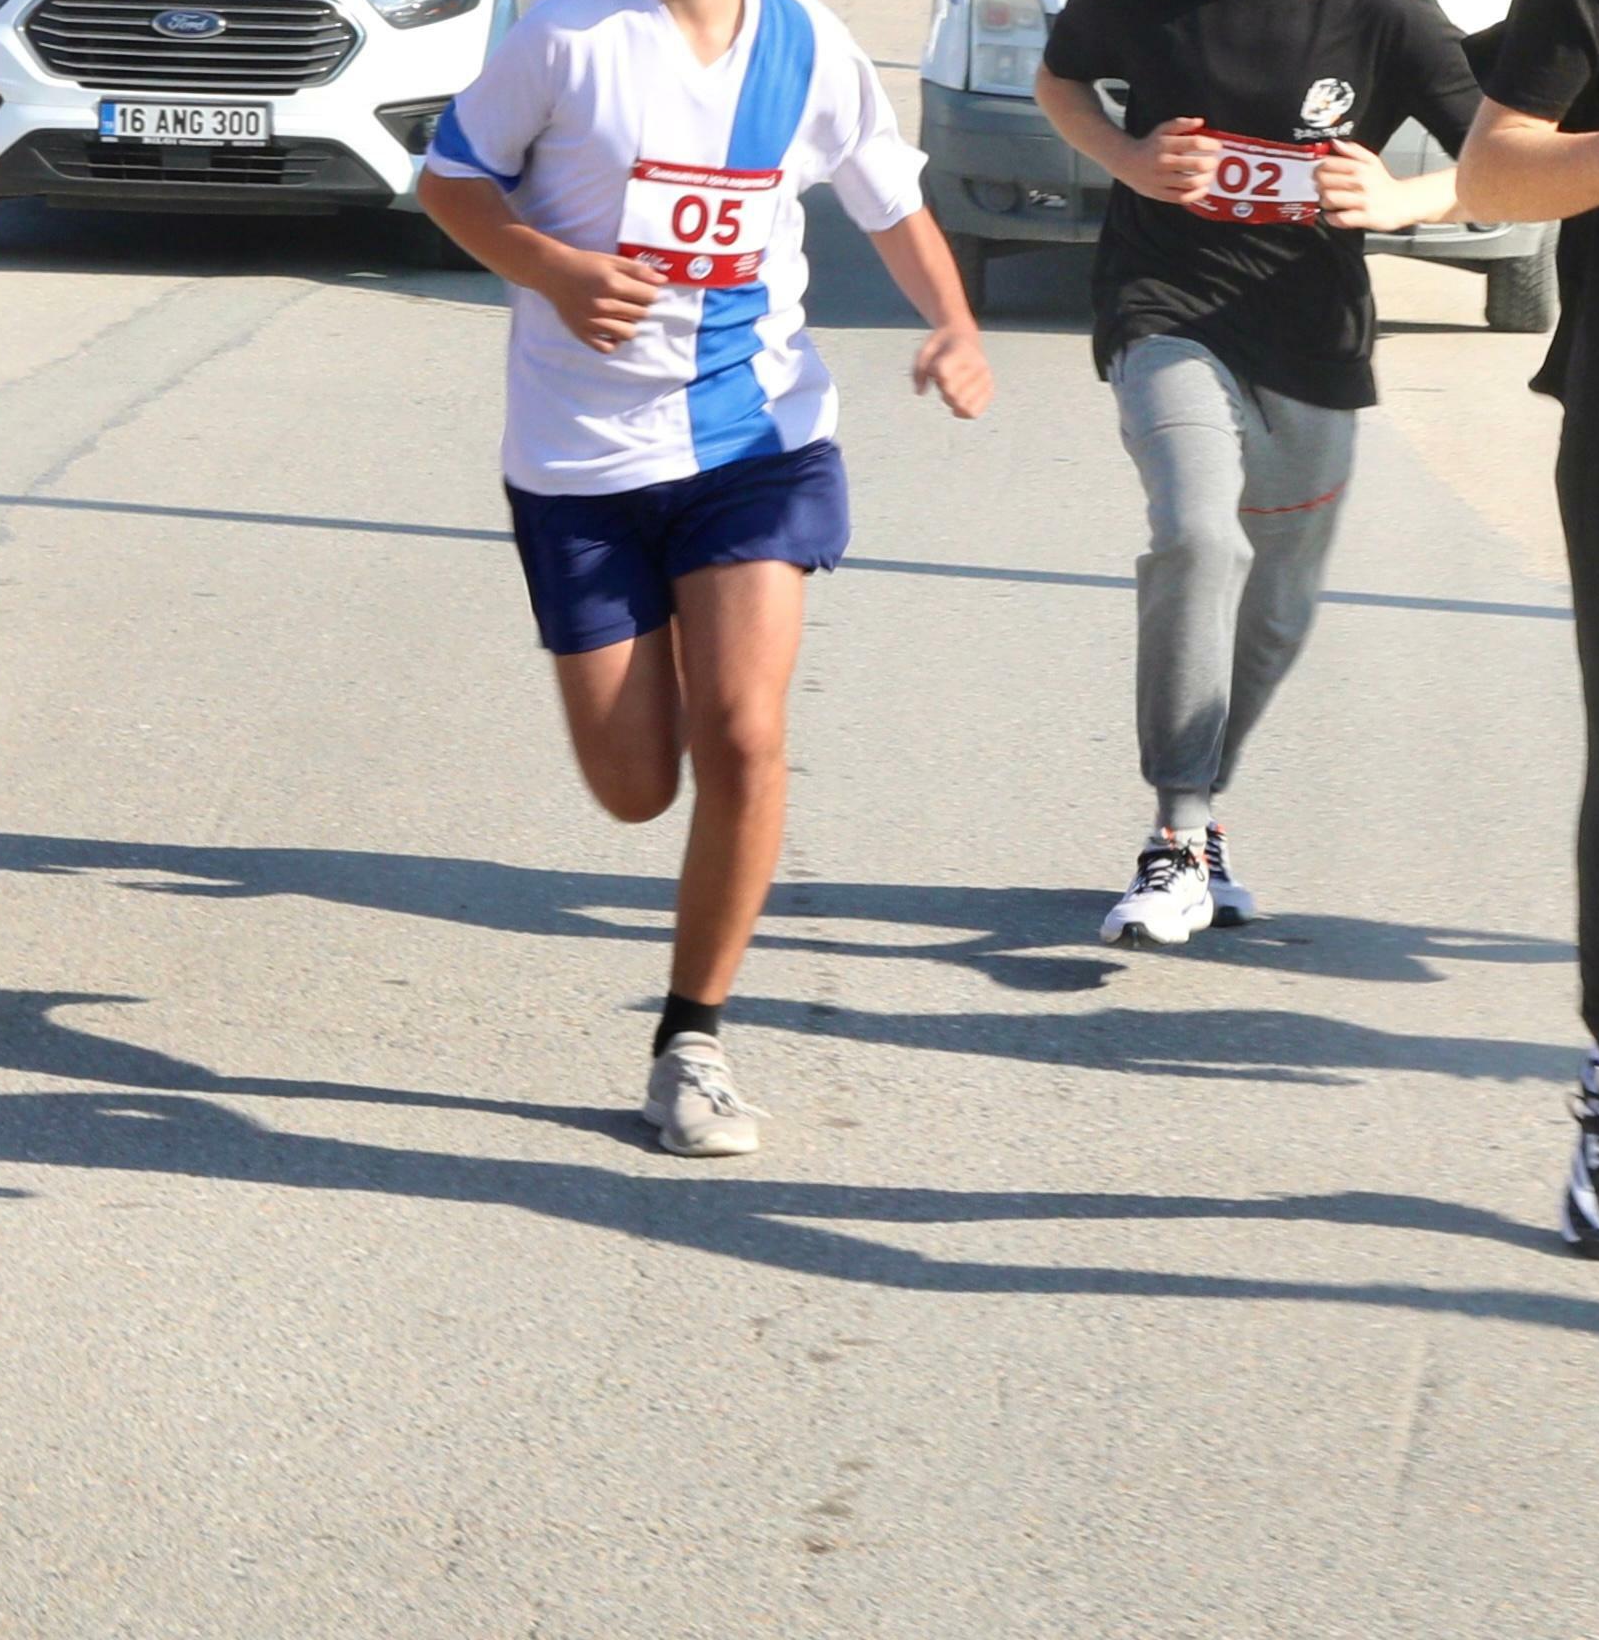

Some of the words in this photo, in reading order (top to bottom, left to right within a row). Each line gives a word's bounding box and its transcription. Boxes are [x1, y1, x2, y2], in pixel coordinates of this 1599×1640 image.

[167, 15, 209, 31] Ford
[119, 108, 145, 133] 16
[212, 110, 260, 136] 300
[1216, 156, 1282, 197] 02
[671, 194, 745, 246] 05
